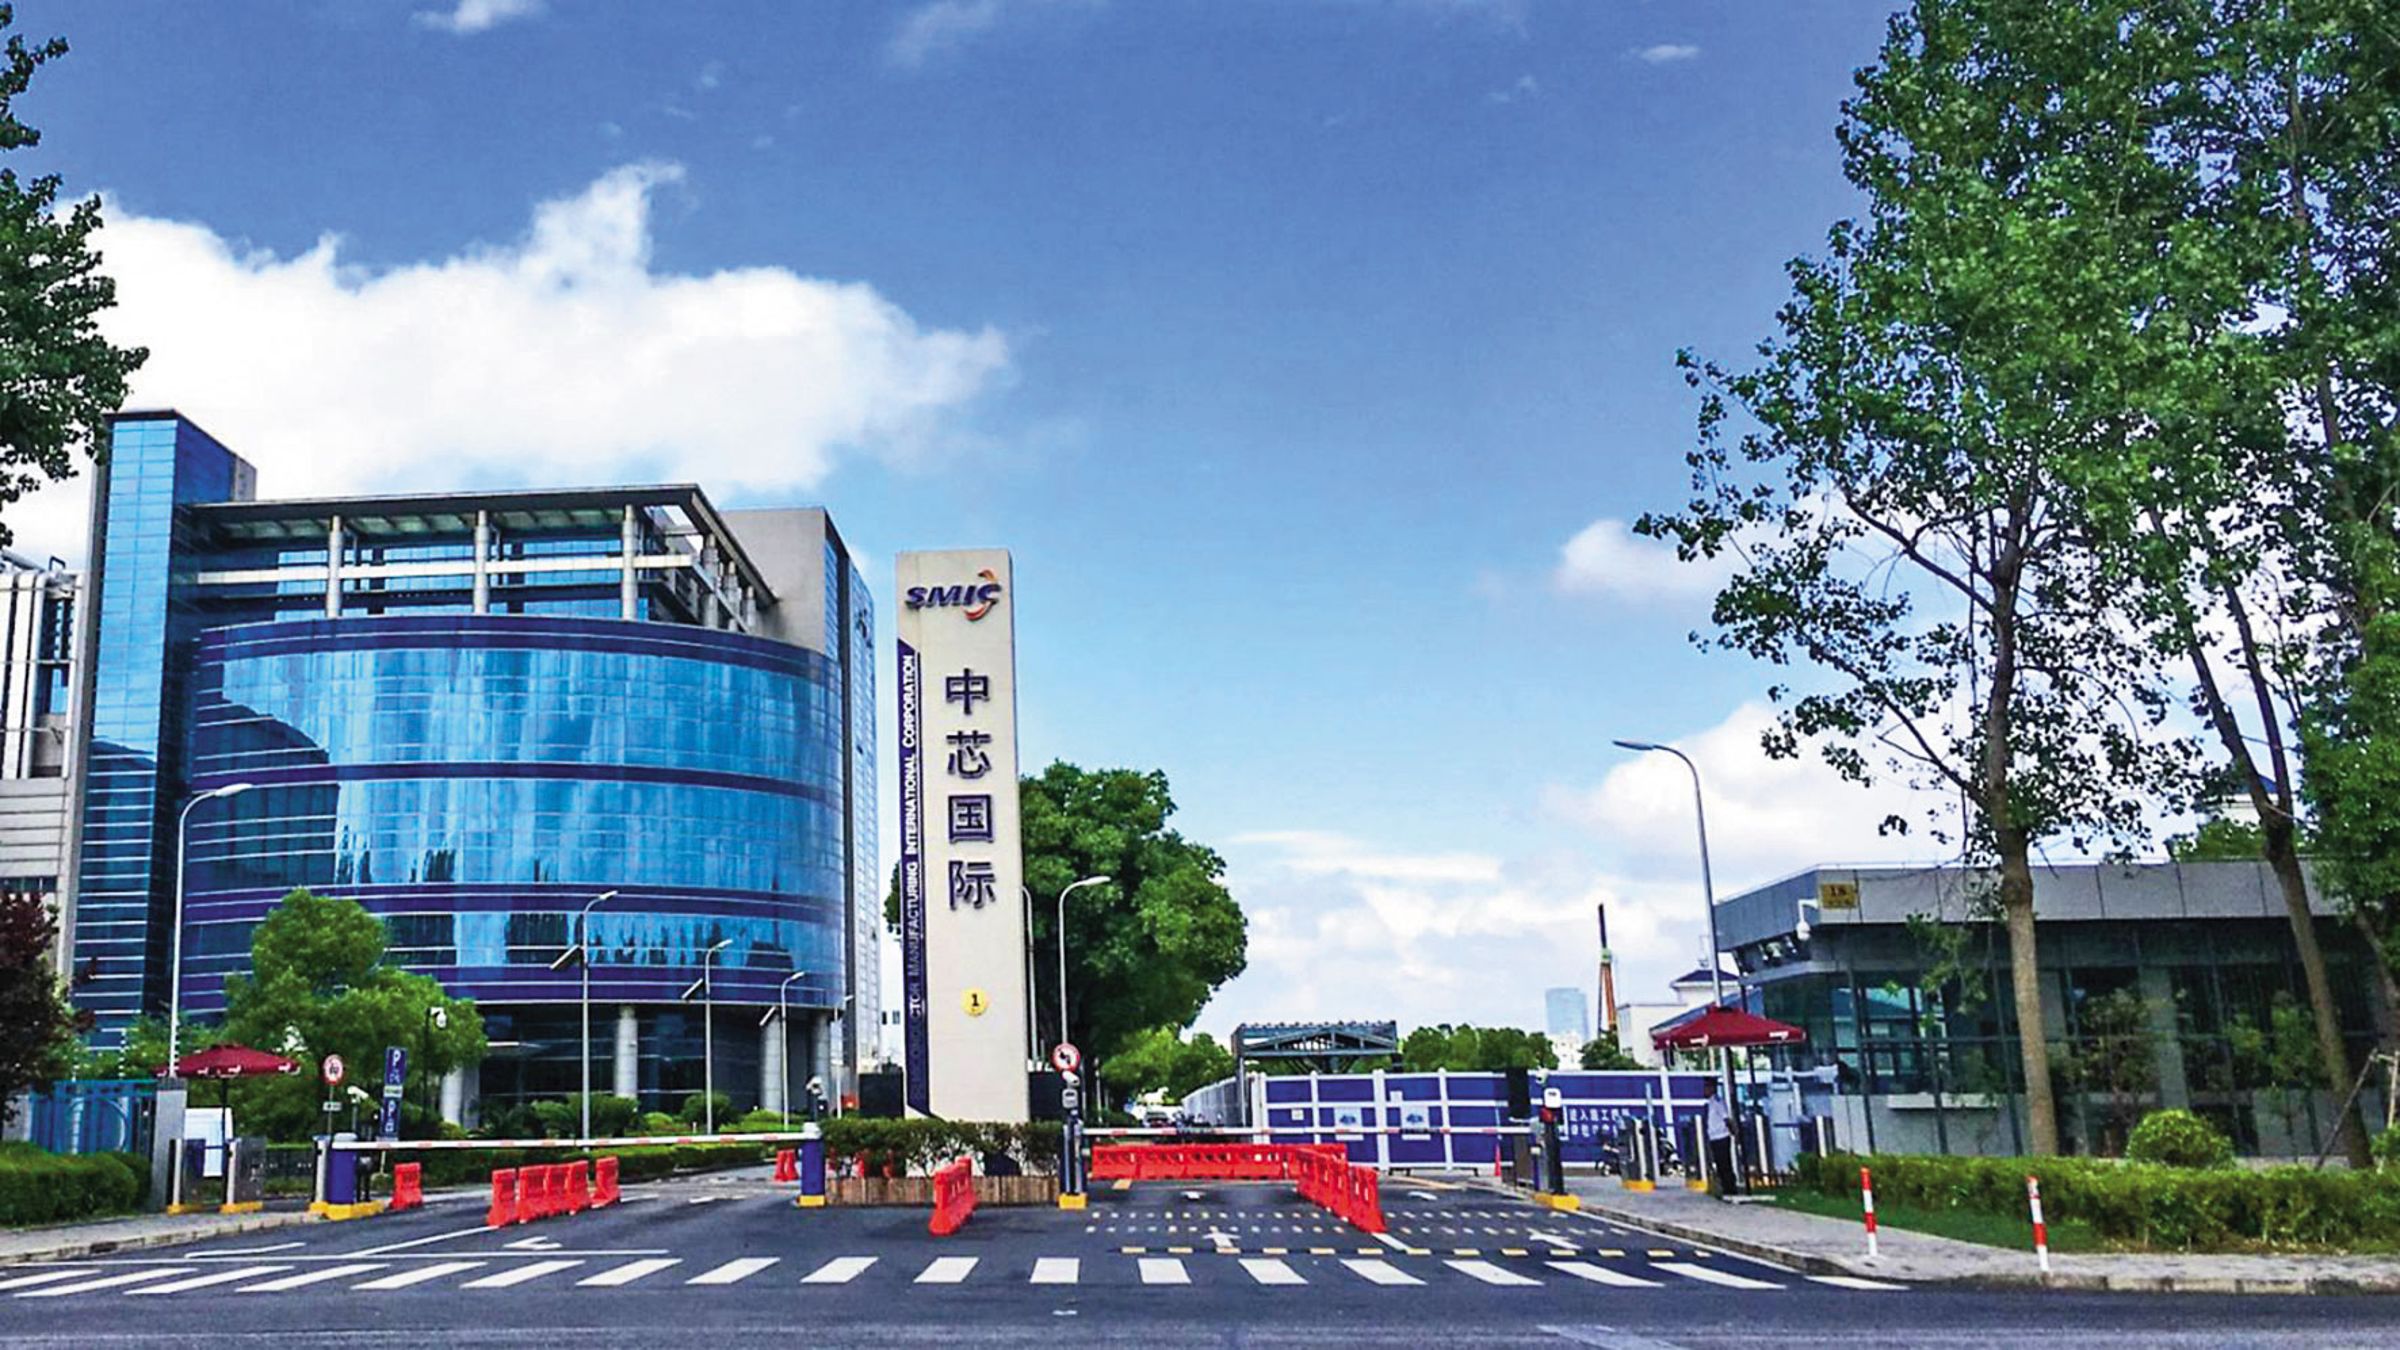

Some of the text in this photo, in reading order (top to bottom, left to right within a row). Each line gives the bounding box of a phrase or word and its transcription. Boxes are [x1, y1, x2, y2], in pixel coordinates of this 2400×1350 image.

[905, 579, 1001, 617] SMIC
[902, 654, 914, 748] CORPORATION
[903, 753, 918, 855] INTERNATIONAL
[945, 667, 996, 911] 中芯国际
[971, 993, 980, 1007] 1
